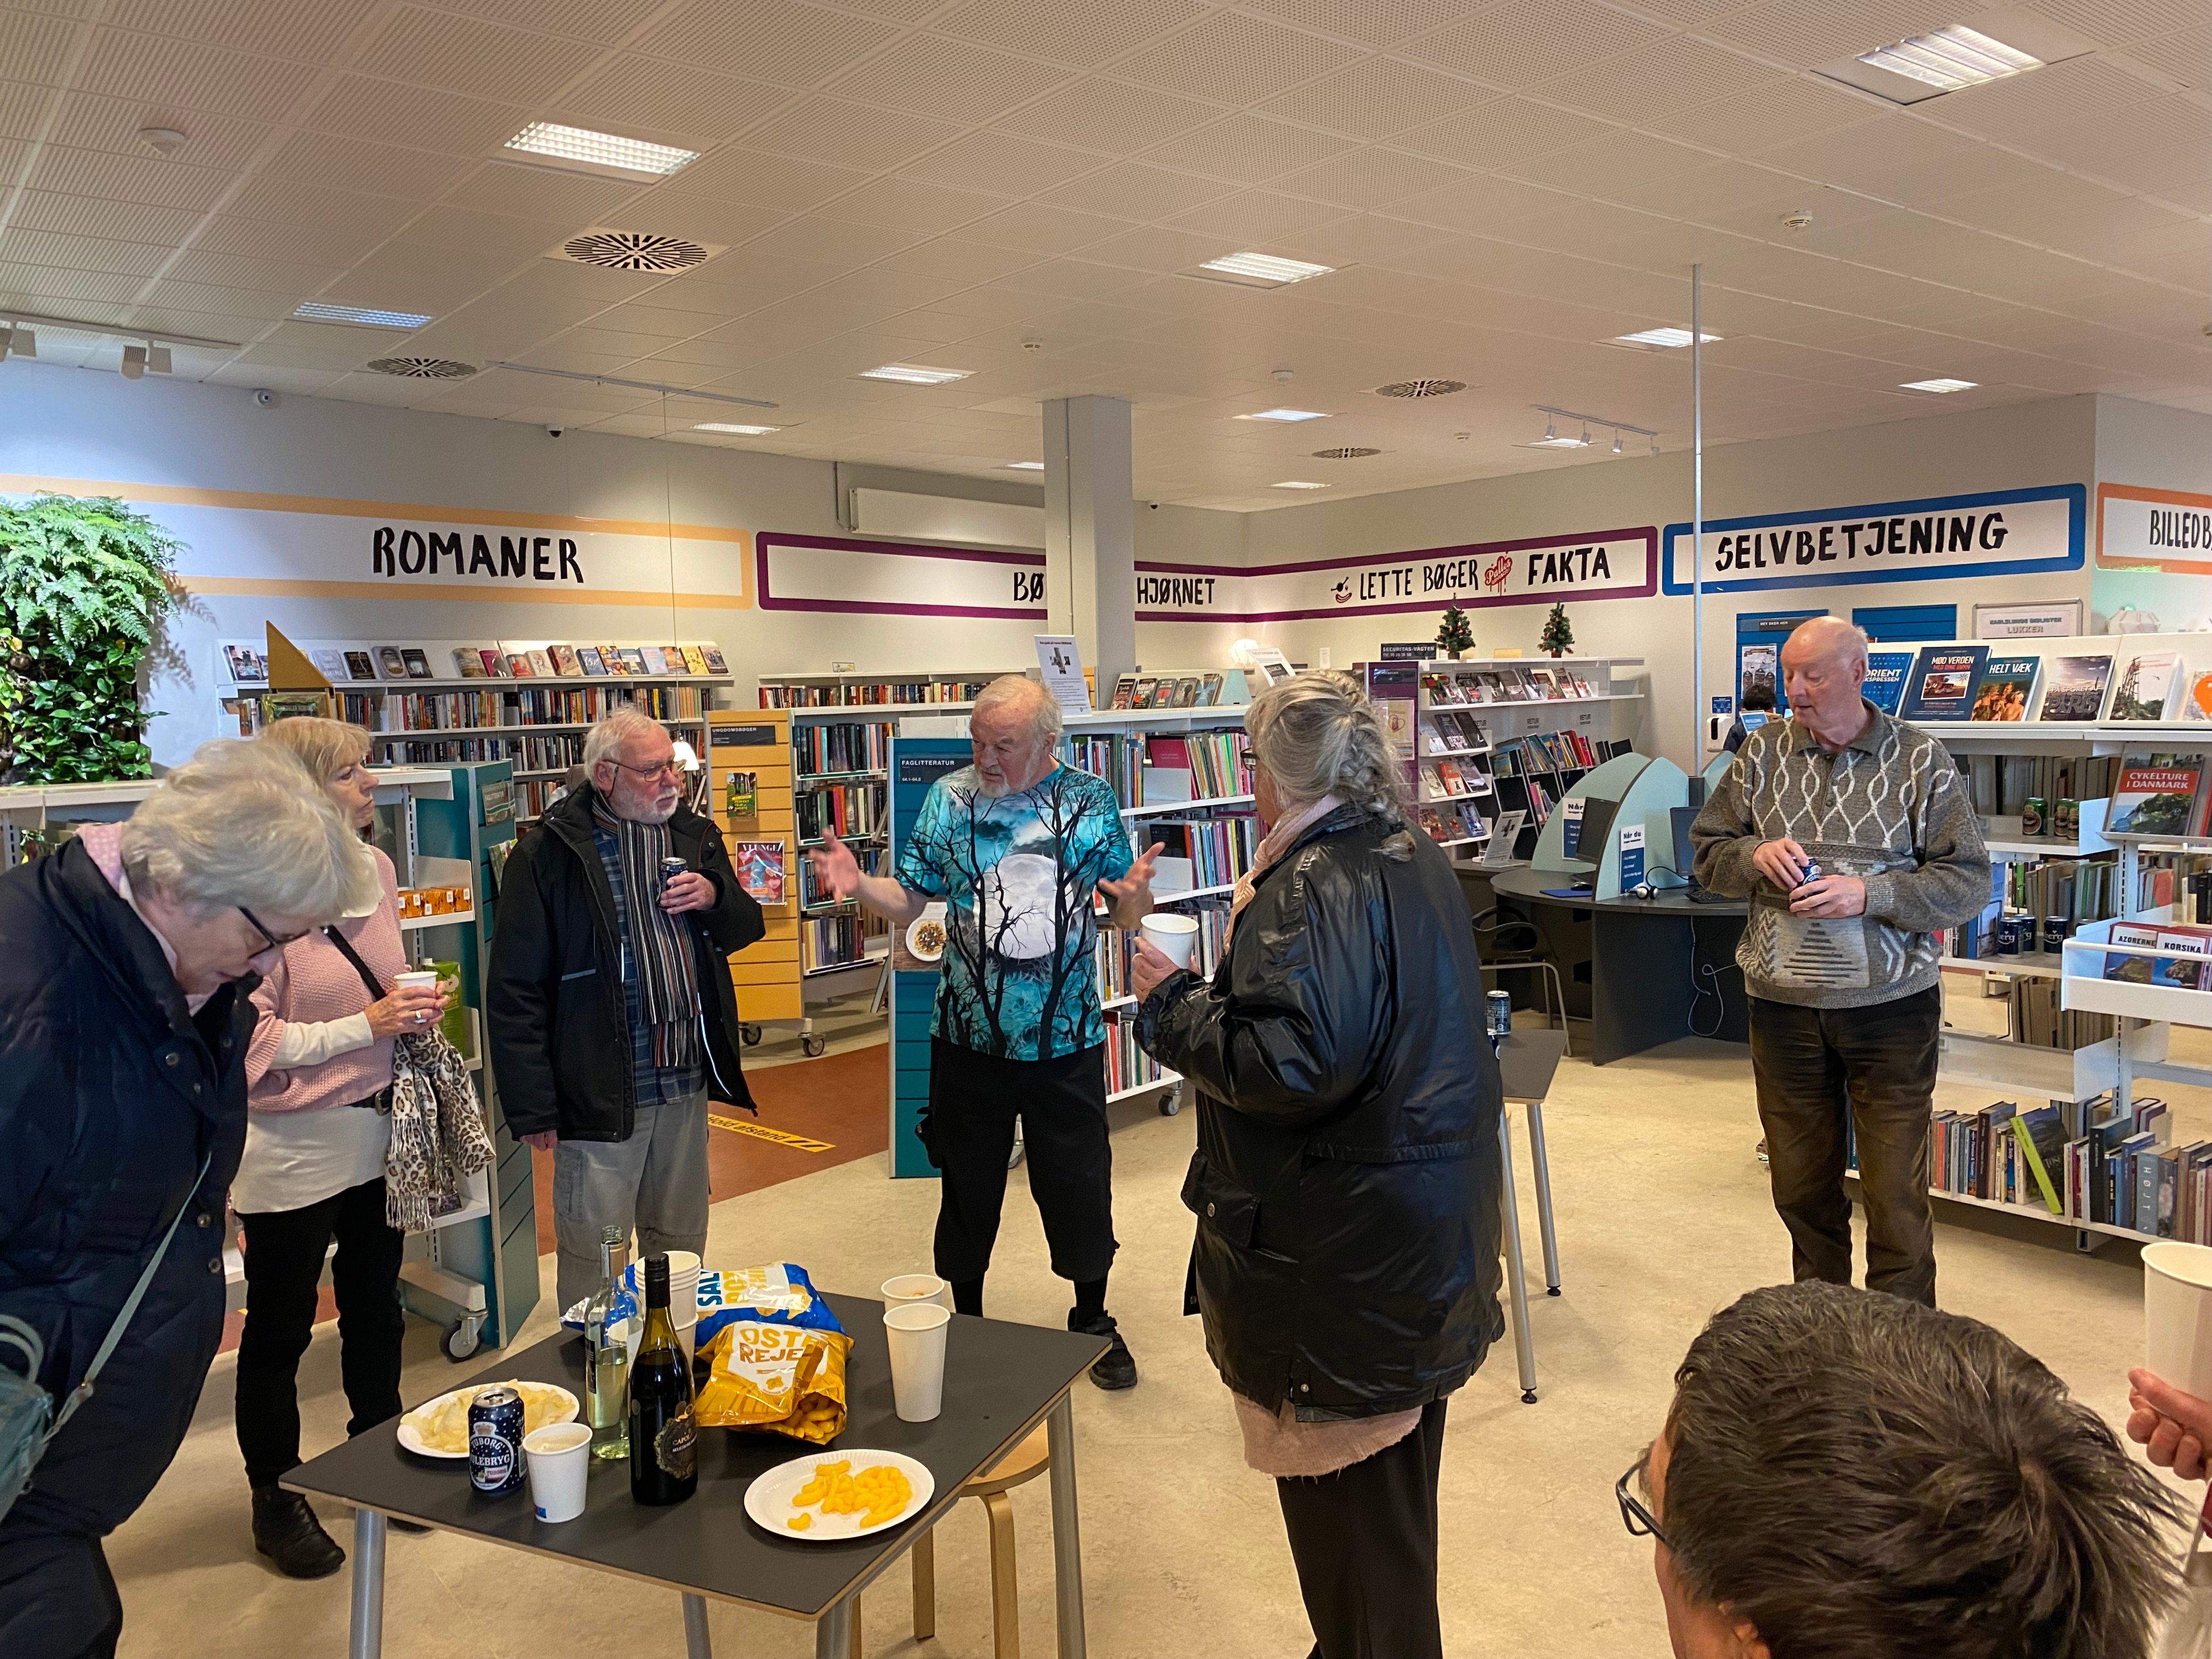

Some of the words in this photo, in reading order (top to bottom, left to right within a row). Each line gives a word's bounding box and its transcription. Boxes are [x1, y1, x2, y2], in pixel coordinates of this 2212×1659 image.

[2150, 510, 2212, 551] BILLEDB
[1715, 512, 2008, 572] SELVBETJENING
[373, 527, 584, 583] ROMANER
[1528, 548, 1611, 585] FAKTA
[1359, 568, 1413, 600] LETTE
[1424, 559, 1479, 592] BØGER
[1948, 656, 1974, 664] VERDEN
[1989, 664, 2011, 674] HELT
[2012, 663, 2033, 673] VÆK
[2046, 695, 2100, 713] PARIS
[2129, 772, 2190, 781] CYKELTURE
[2118, 936, 2156, 946] AZORERNE
[2164, 943, 2201, 953] KORSIKA
[733, 1125, 790, 1141] afstand
[697, 1268, 723, 1307] SAL
[471, 1437, 505, 1450] TUBORG
[470, 1454, 510, 1466] ULEBRYG
